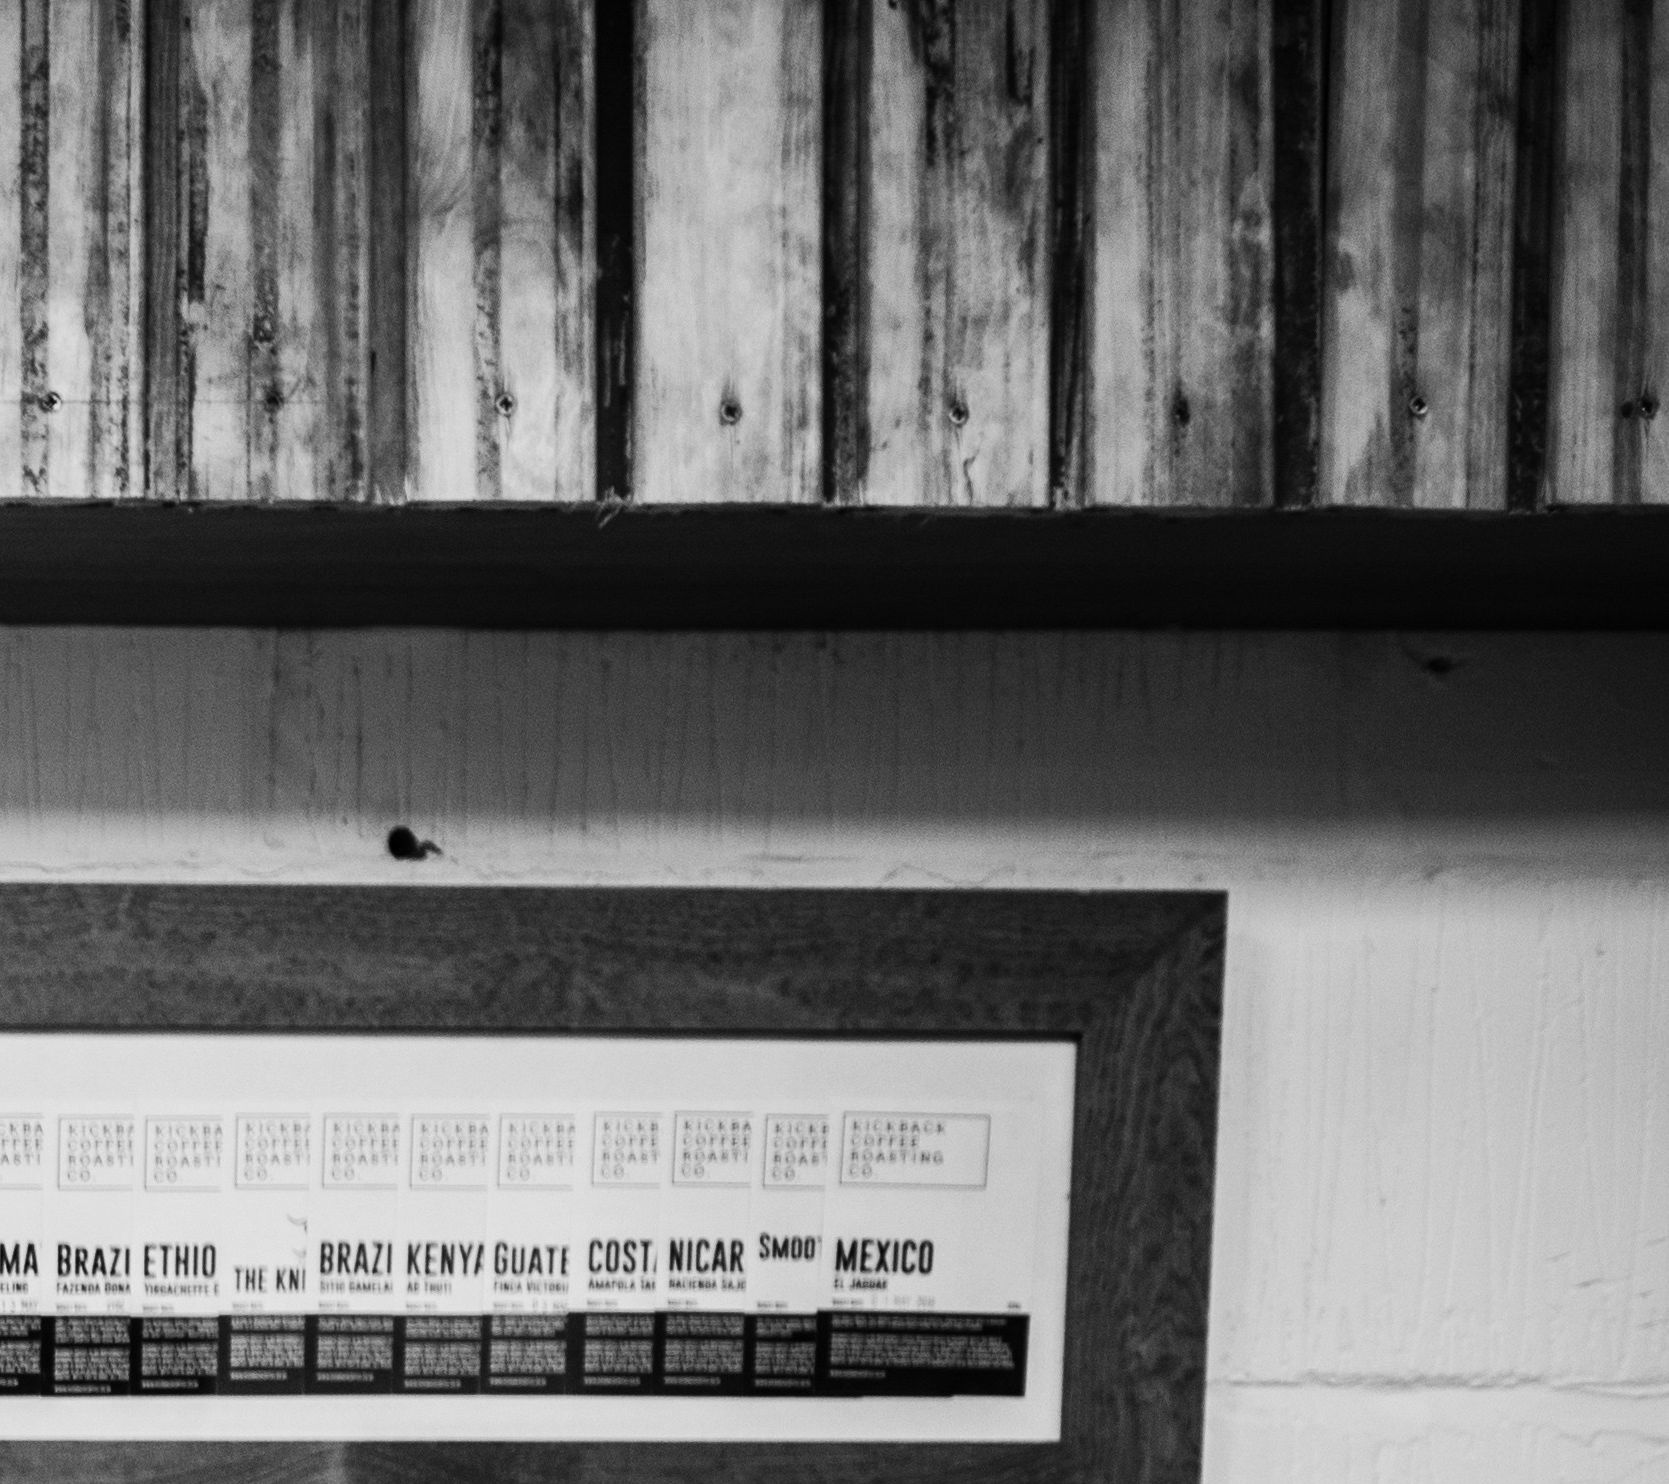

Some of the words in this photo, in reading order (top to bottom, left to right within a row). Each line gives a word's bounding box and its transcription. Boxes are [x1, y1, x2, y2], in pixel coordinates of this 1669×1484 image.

[143, 1244, 216, 1279] ETHIO
[835, 1237, 934, 1275] MEXICO
[234, 1265, 267, 1294] THE
